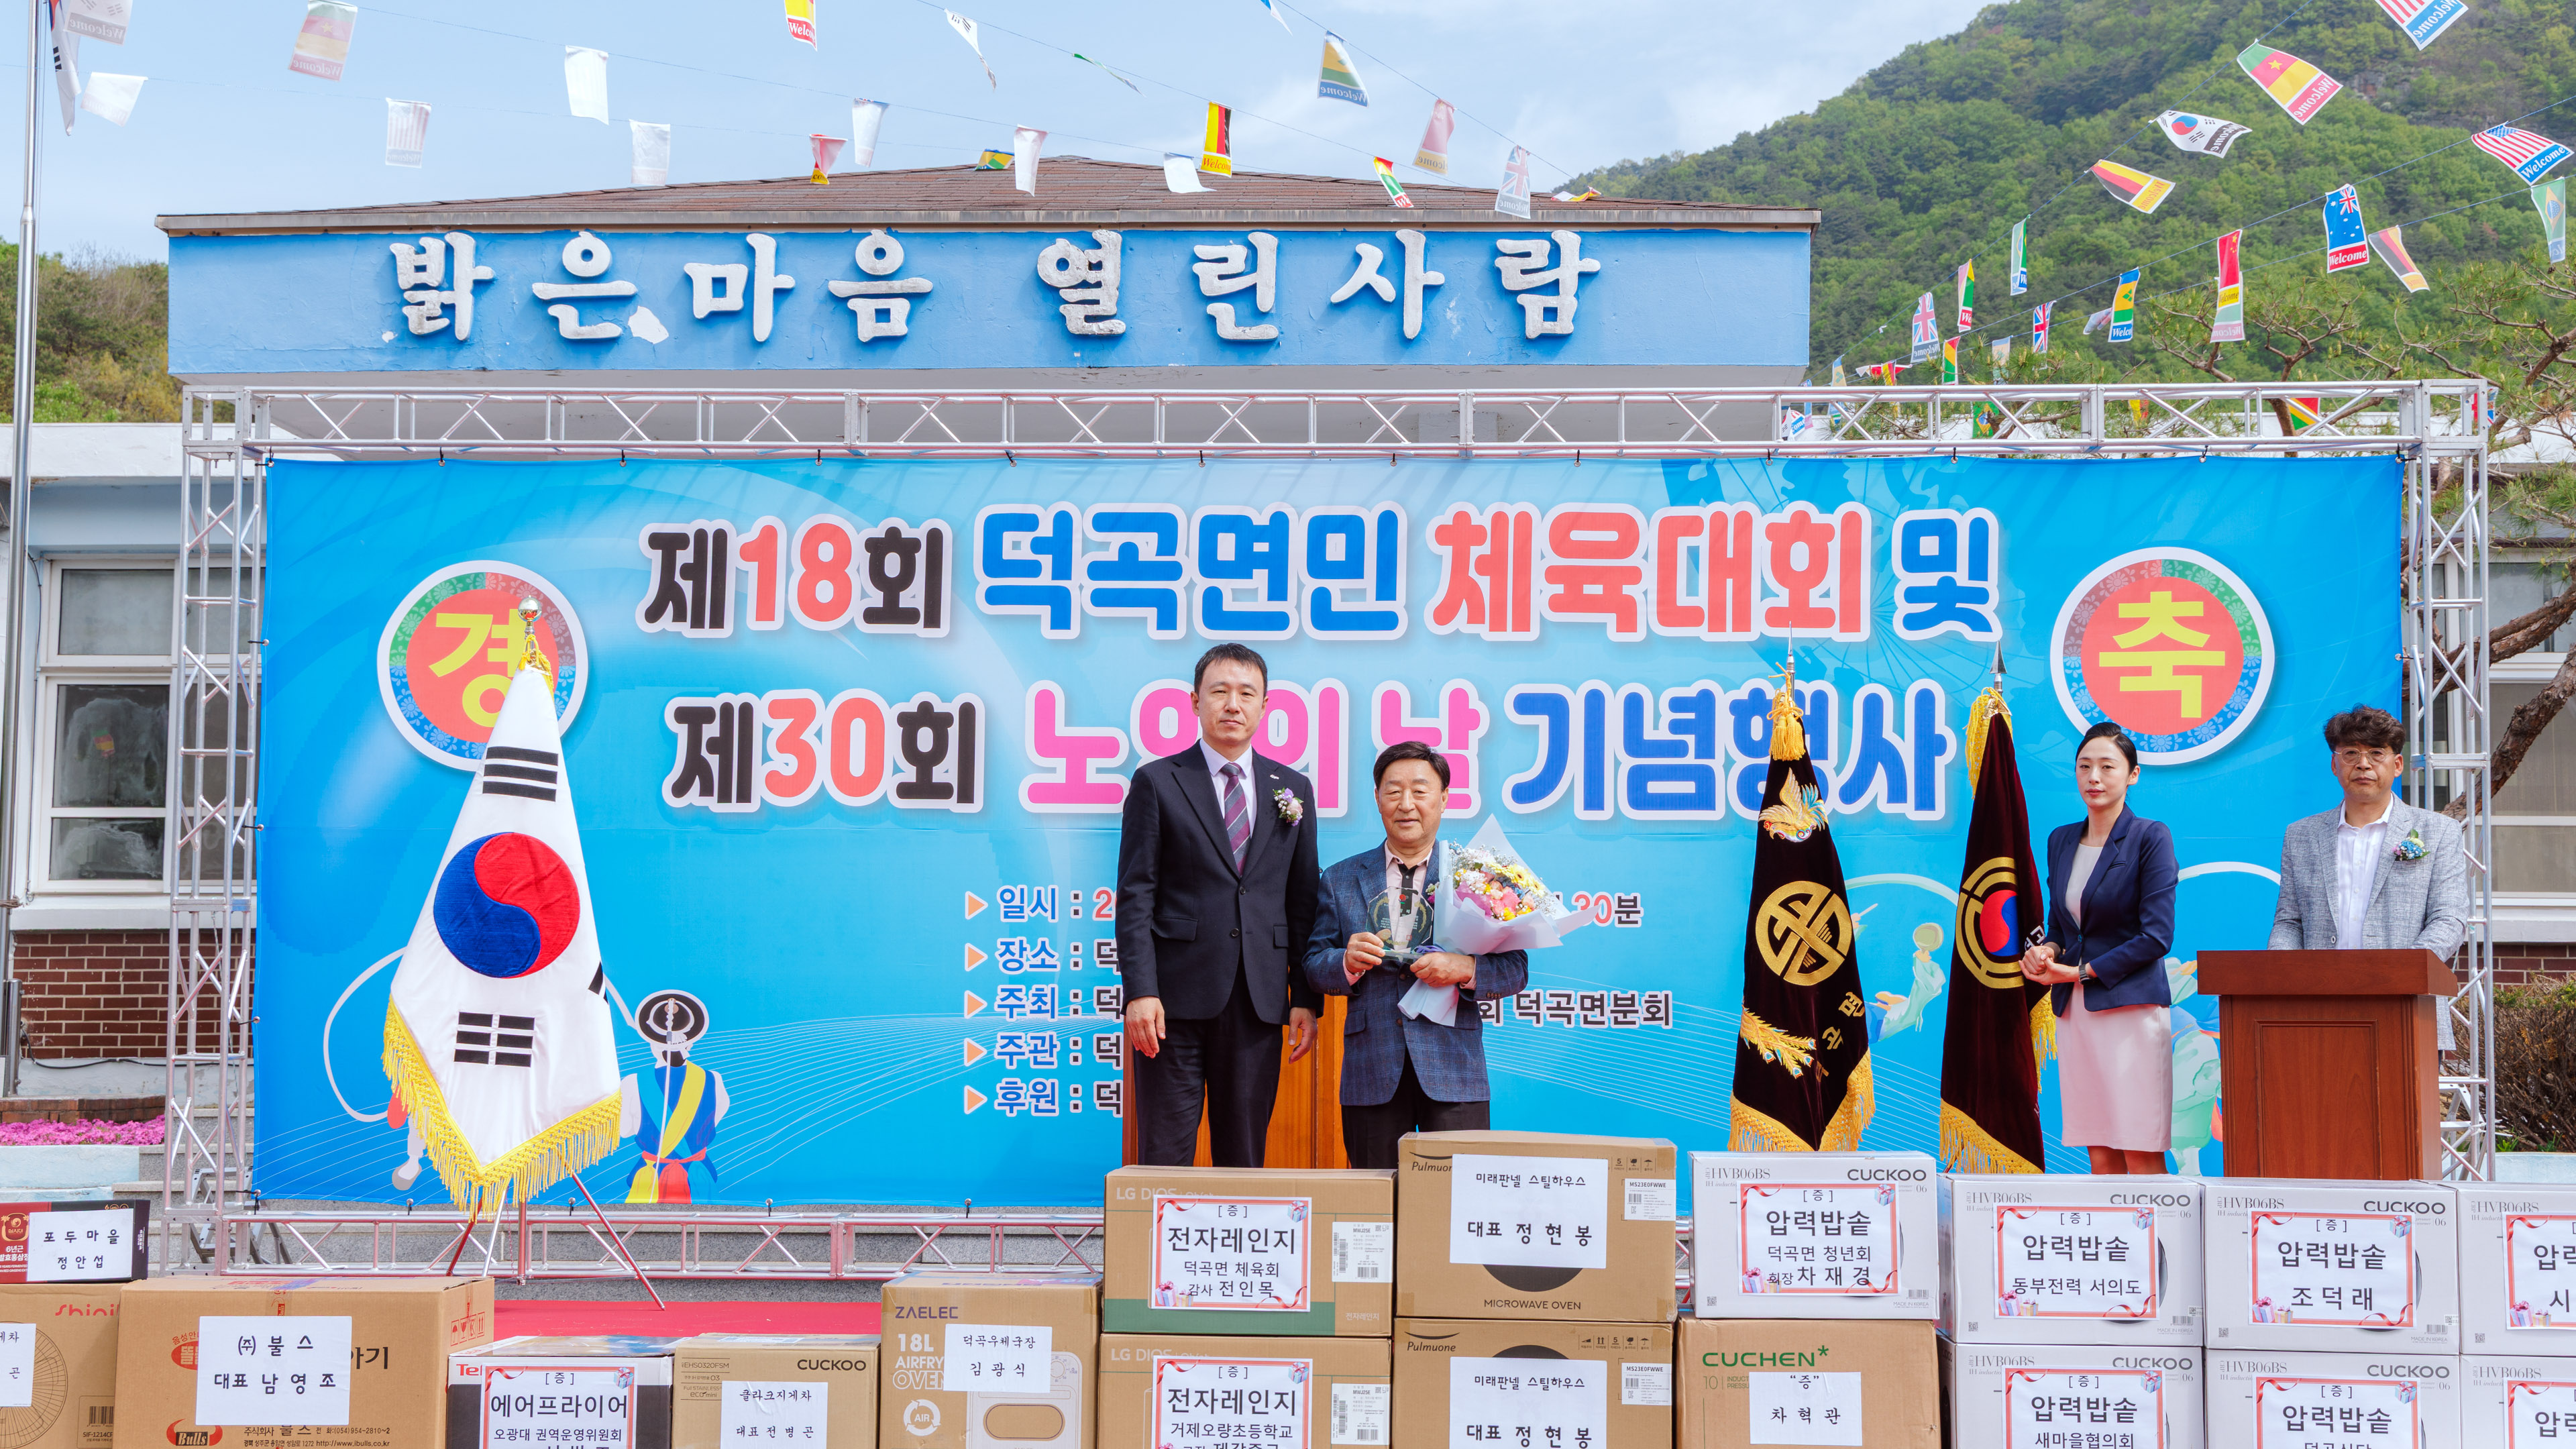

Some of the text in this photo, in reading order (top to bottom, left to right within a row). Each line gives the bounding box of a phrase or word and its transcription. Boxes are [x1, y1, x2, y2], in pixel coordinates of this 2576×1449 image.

[2521, 146, 2565, 179] Welcome
[2328, 250, 2367, 266] Welcome
[389, 228, 1602, 343] 밝은 마음 열린 사람
[643, 509, 1992, 634] 제18회 덕곡면민 체육대회 및
[2098, 590, 2226, 718] 축
[671, 698, 975, 804] 제30회
[999, 887, 1056, 920] 일시
[998, 939, 1057, 971] 장소
[997, 987, 1055, 1019] 주최
[1515, 992, 1670, 1026] 덕곡면분회
[997, 1034, 1121, 1067] 주관 덕
[997, 1081, 1121, 1115] 후원 덕
[1476, 1173, 1586, 1189] 미래판넬 스틸하우스
[1712, 1168, 1927, 1181] HVB06BS CUCKOO
[1116, 1187, 1136, 1200] LG
[1916, 1184, 1927, 1193] 06
[1973, 1192, 2190, 1206] HVB06BS CUCKOO
[2223, 1197, 2446, 1215] HVB06BS CUCKOO
[1468, 1221, 1502, 1237] 대표
[1766, 1210, 1872, 1236] 압력밥솥
[2434, 1218, 2447, 1226] 06
[1167, 1226, 1295, 1254] 전자레인지
[2023, 1234, 2129, 1262] 압력밥솥
[6, 1245, 24, 1253] 6년근
[1768, 1245, 1871, 1263] 덕곡면 청년회
[2277, 1241, 2386, 1270] 압력밥솥
[1184, 1260, 1279, 1278] 덕곡면 체육회
[1768, 1272, 1794, 1285] 회장
[2012, 1277, 2142, 1296] 동부전력 서의도
[1188, 1283, 1213, 1297] 감사
[895, 1306, 959, 1319] ZAELEC
[1484, 1299, 1581, 1310] MICROWAVE OVEN
[1345, 1312, 1380, 1321] 전자레인지
[898, 1334, 934, 1352] 18L
[963, 1334, 1036, 1349] 덕곡우체국장
[1407, 1342, 1456, 1352] Pulmuone
[1112, 1348, 1130, 1361] LG
[797, 1359, 867, 1371] CUCKOO
[2112, 1357, 2193, 1370] CUCKOO
[2226, 1360, 2450, 1379] HVB06BS CUCKOO
[2479, 1366, 2542, 1379] HVB06BS
[214, 1373, 248, 1389] 대표
[1474, 1376, 1585, 1391] 미래판넬 스틸하우스
[1703, 1375, 1718, 1390] 10
[740, 1389, 812, 1402] 클라크지게차
[1167, 1387, 1296, 1416] 전자레인지
[490, 1394, 628, 1418] 에어프라이어
[2031, 1396, 2138, 1424] 압력밥솥
[914, 1413, 930, 1422] AIR
[2282, 1405, 2392, 1434] 압력밥솥
[178, 1432, 208, 1446] Bulls
[244, 1427, 274, 1436] 주식회사
[494, 1428, 622, 1442] 오광대 권역운영위원회
[737, 1426, 759, 1438] 대표
[1170, 1422, 1293, 1440] 거제오량초등학교
[1466, 1424, 1501, 1441] 대표
[2035, 1432, 2134, 1449] 새마을협의회
